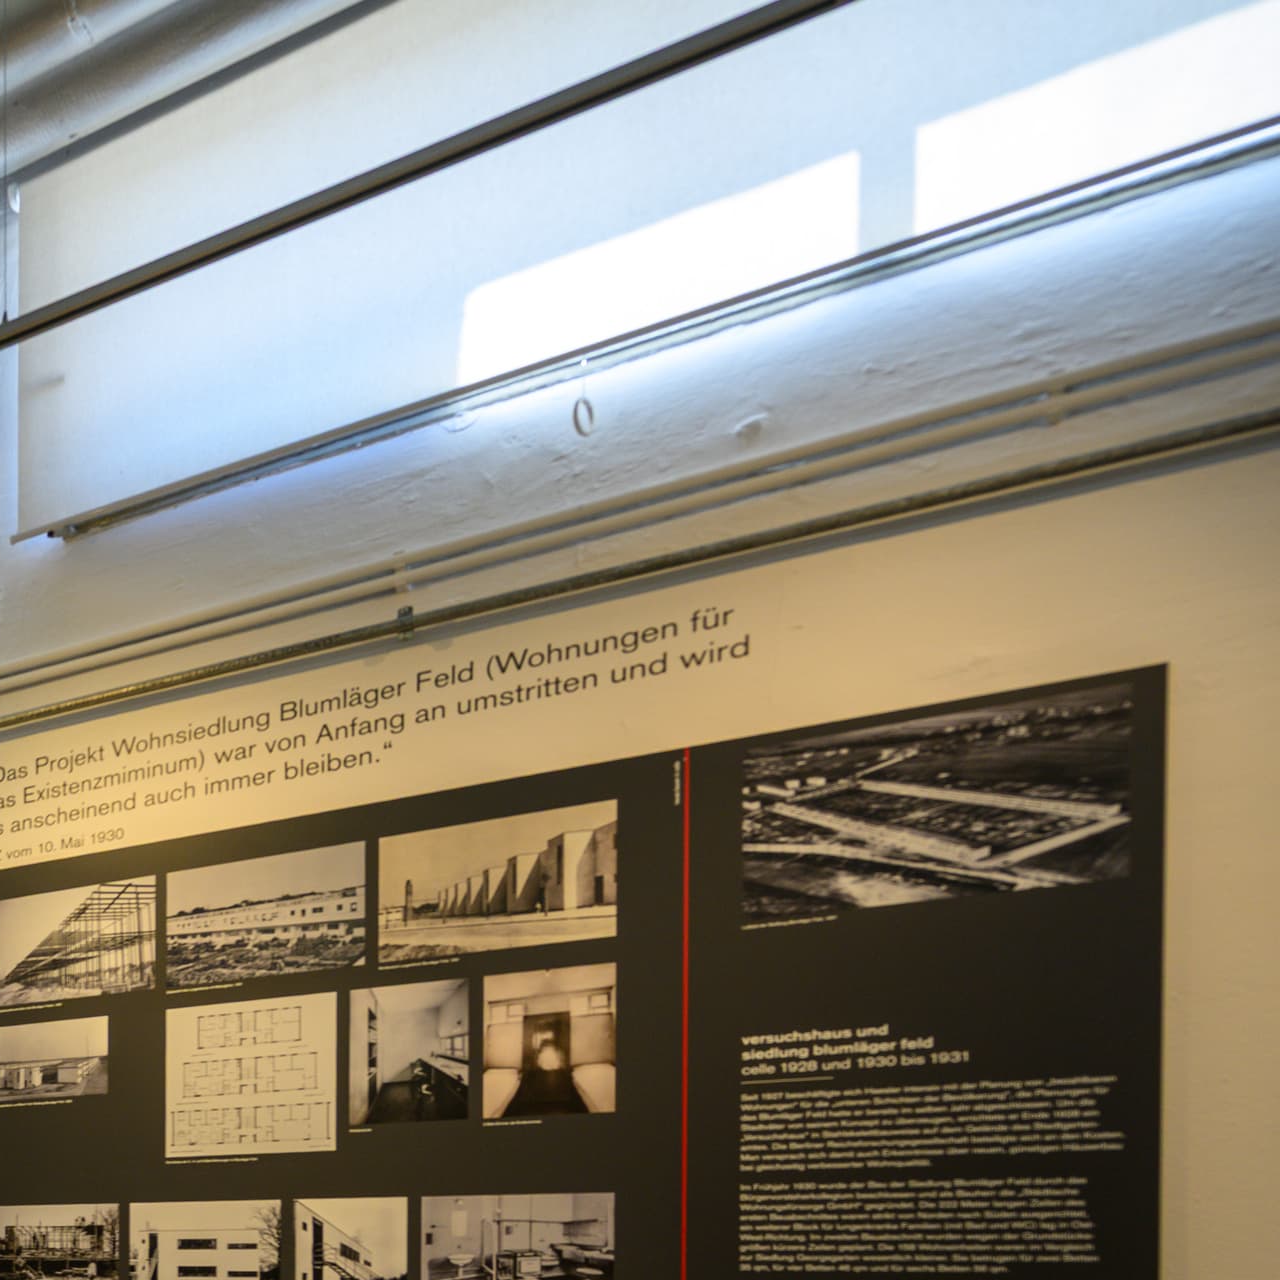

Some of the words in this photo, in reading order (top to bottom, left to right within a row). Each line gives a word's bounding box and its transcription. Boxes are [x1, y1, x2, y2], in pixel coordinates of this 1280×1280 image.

[35, 746, 104, 775] Projekt
[112, 712, 270, 757] Wohnsiedlung
[280, 681, 407, 722] Blumläger
[416, 659, 475, 694] Feld
[486, 621, 679, 682] (Wohnungen
[689, 606, 735, 634] für
[23, 750, 205, 804] Existenzmiminum)
[214, 744, 257, 764] war
[264, 734, 306, 754] von
[315, 712, 406, 745] Anfang
[414, 704, 447, 724] an
[456, 672, 599, 716] umstritten
[610, 650, 669, 685] und
[678, 633, 751, 670] wird
[10, 792, 136, 833] anscheinend
[144, 781, 196, 807] auch
[204, 769, 276, 795] immer
[5, 847, 33, 860] vom
[38, 840, 57, 854] 10.
[60, 836, 84, 850] Mai
[91, 827, 125, 844] 1930
[741, 1029, 852, 1045] versuchshaus
[856, 1024, 889, 1037] und
[741, 1047, 810, 1061] siedlung
[812, 1041, 897, 1056] blumläger
[900, 1037, 934, 1050] feld
[741, 1063, 776, 1076] celle
[780, 1060, 818, 1073] 1928
[821, 1058, 851, 1071] und
[857, 1055, 898, 1068] 1930
[900, 1055, 926, 1066] bis
[931, 1051, 969, 1063] 1931
